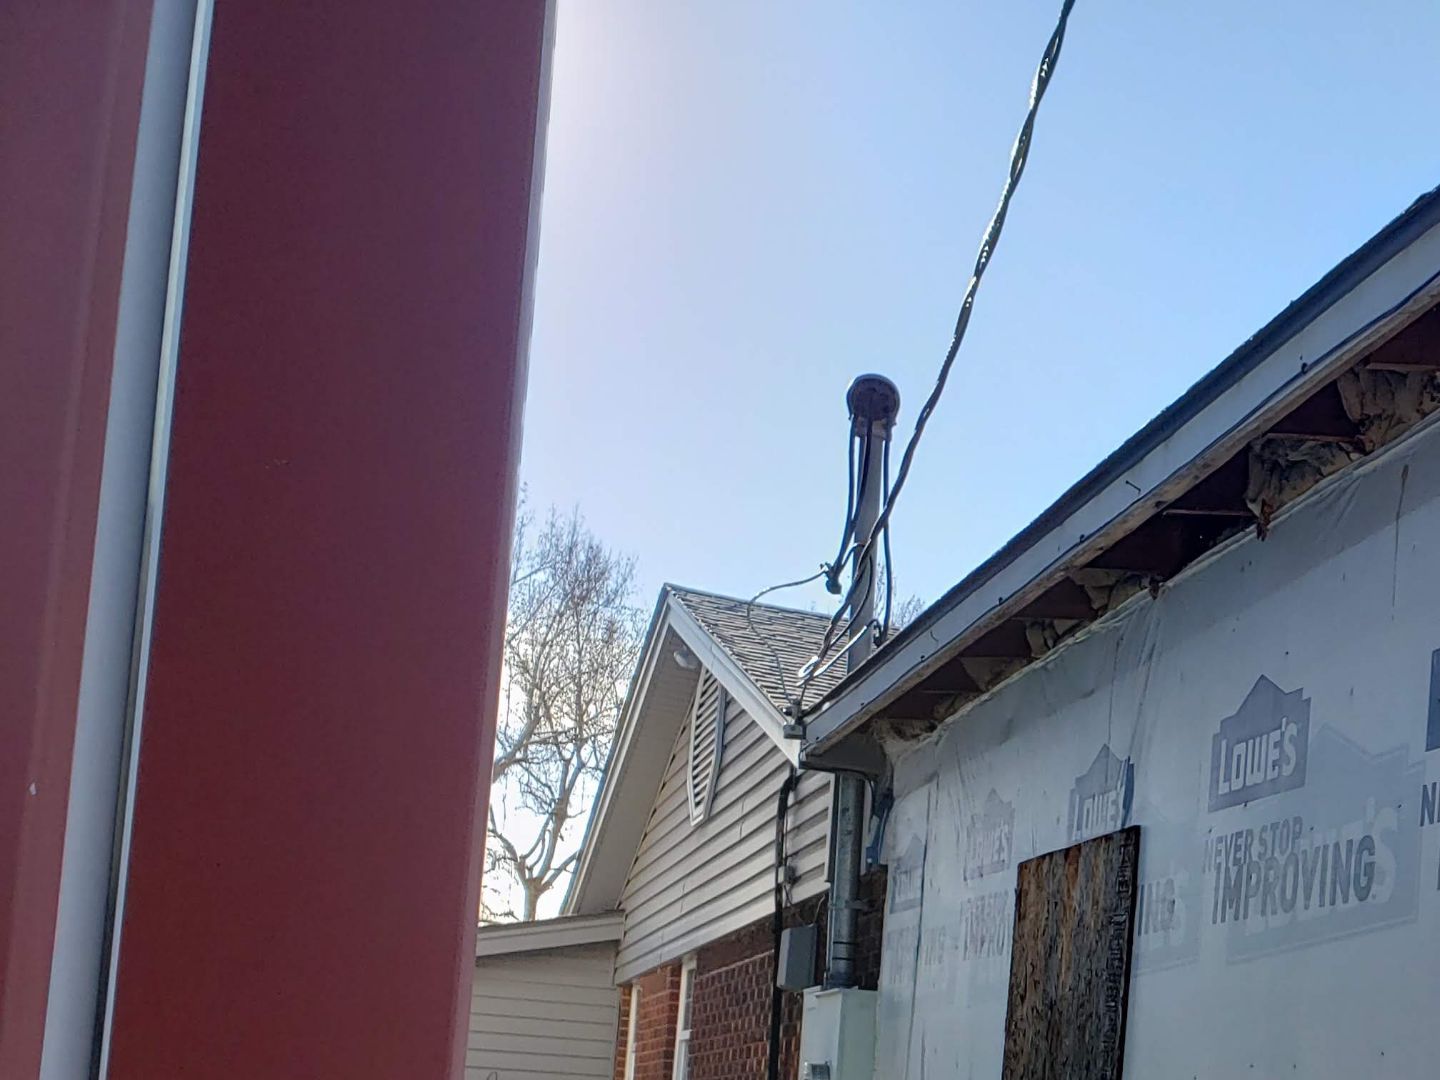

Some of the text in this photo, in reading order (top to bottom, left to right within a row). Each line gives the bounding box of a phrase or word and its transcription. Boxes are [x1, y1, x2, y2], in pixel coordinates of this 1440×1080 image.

[1219, 717, 1298, 795] LOWE'S
[1202, 816, 1303, 874] NEVER STOP
[1212, 835, 1376, 925] IMPROVING
